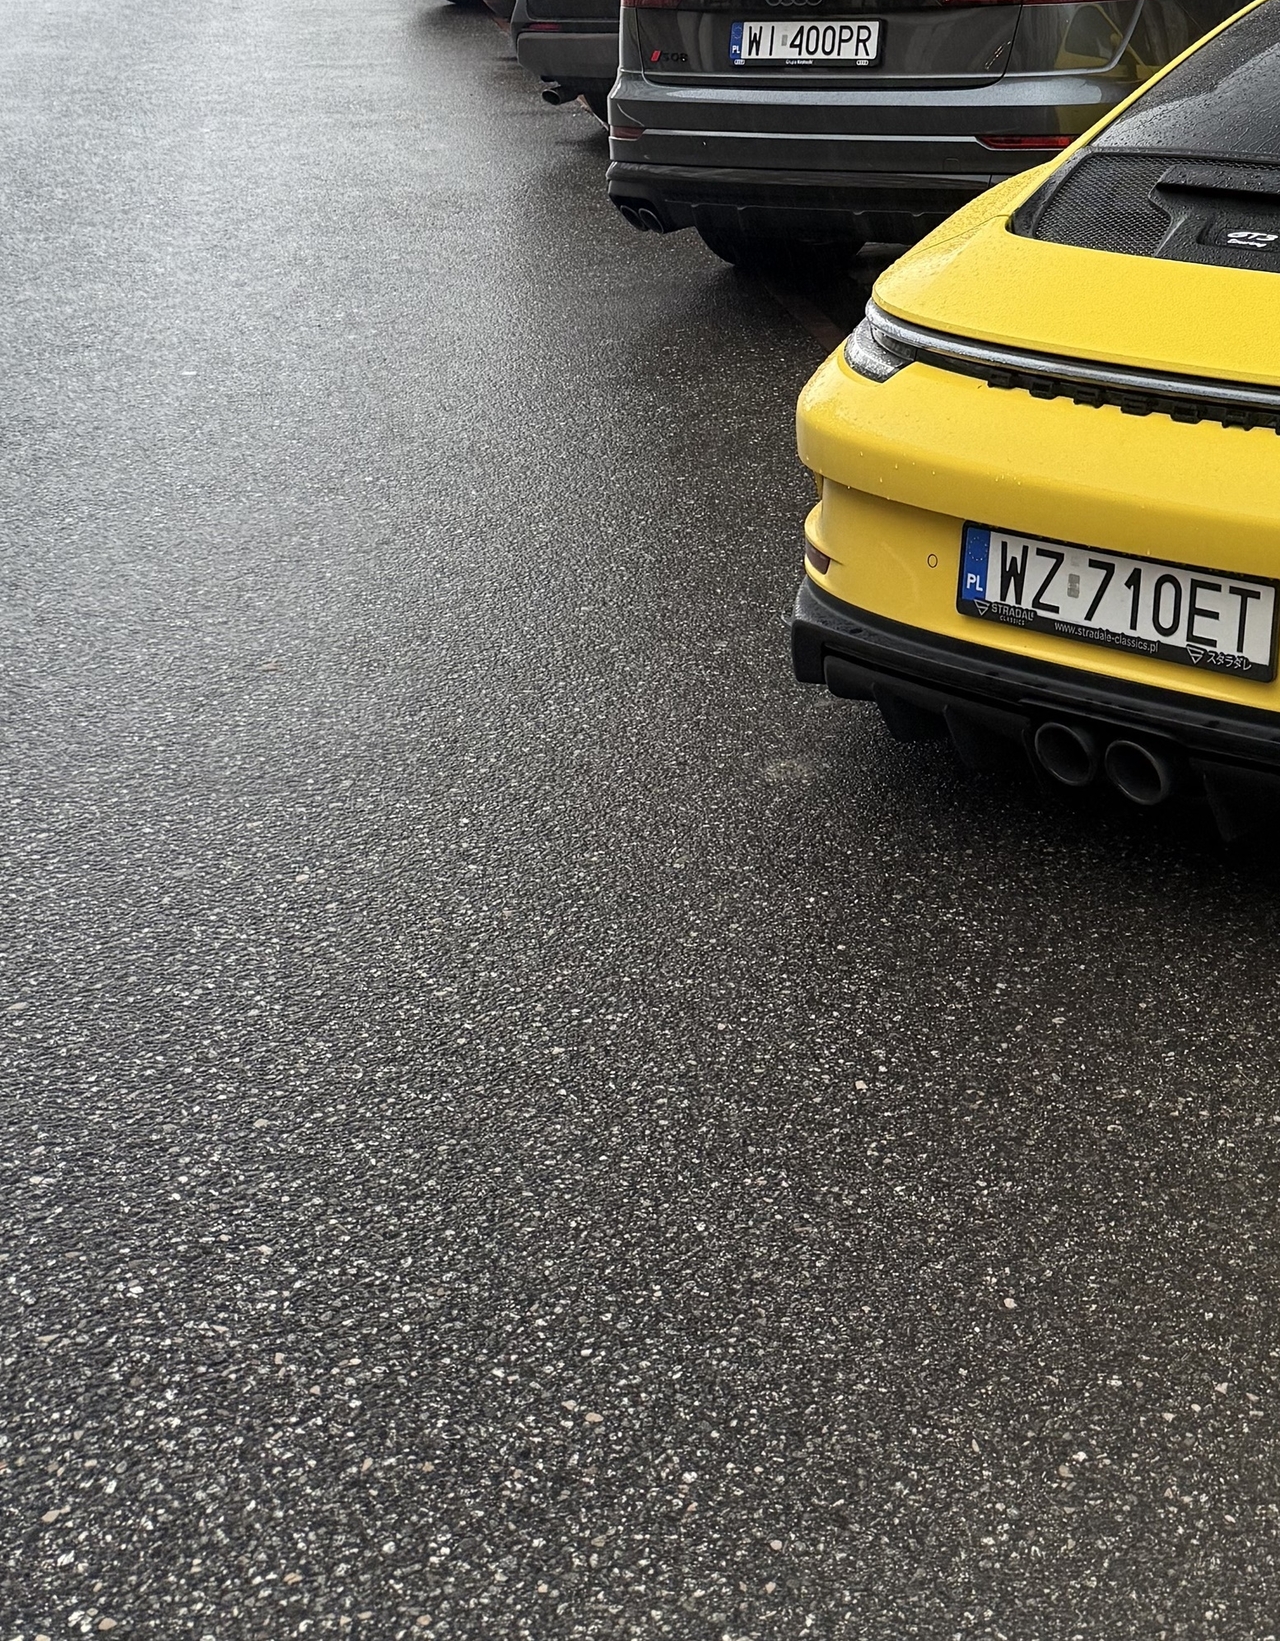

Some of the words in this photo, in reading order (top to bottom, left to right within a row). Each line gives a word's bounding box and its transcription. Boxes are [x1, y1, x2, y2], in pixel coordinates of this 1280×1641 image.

[748, 25, 775, 56] WI
[789, 25, 872, 57] 400PR
[966, 573, 984, 592] PL
[1000, 540, 1065, 614] WZ
[1084, 559, 1261, 653] 710ET
[1054, 621, 1159, 653] www.stradale-classics.pl
